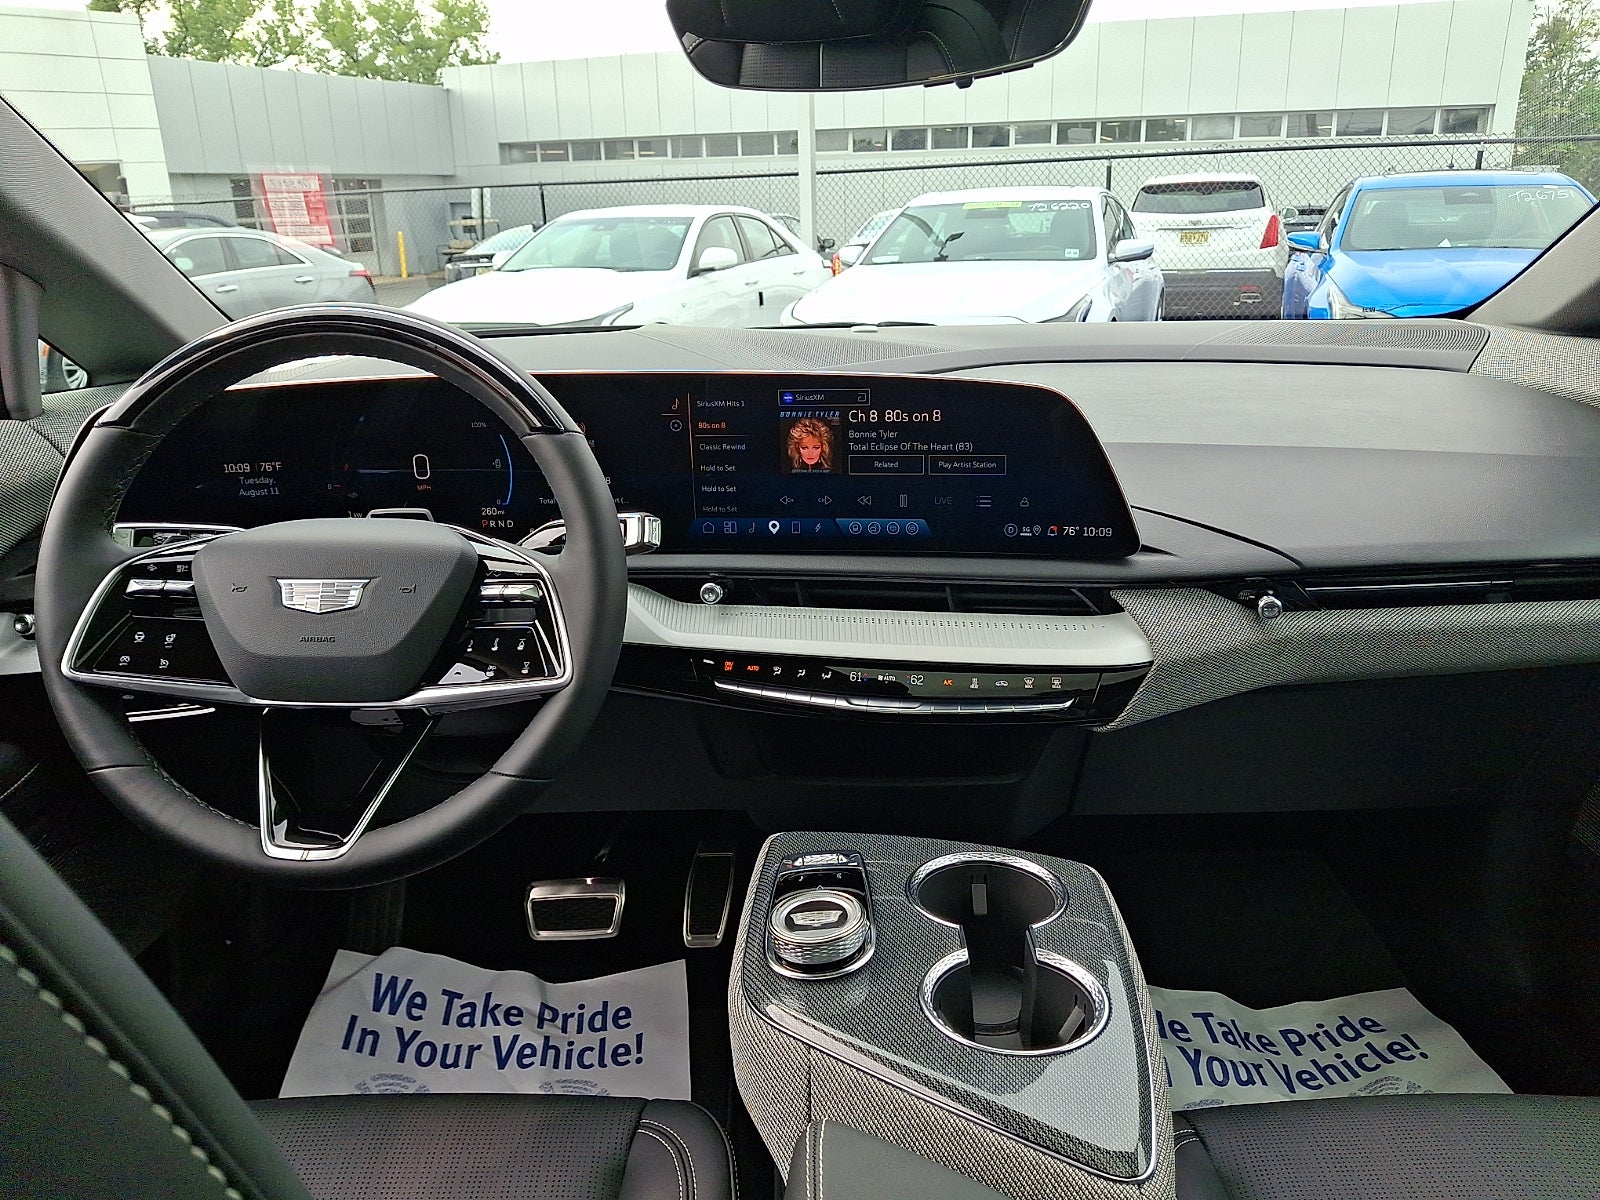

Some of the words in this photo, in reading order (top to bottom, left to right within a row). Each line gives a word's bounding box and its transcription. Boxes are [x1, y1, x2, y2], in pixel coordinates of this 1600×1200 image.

[696, 400, 726, 408] SiriusXM
[815, 410, 840, 418] TYLER
[848, 409, 866, 423] Ch
[869, 409, 878, 422] 8
[884, 409, 909, 423] 80s
[912, 412, 929, 422] on
[932, 409, 942, 422] 8
[698, 421, 711, 429] 80s
[848, 429, 877, 439] Bonnie
[879, 429, 898, 440] Tyler
[699, 443, 721, 451] Classic
[722, 443, 746, 451] Rewind
[848, 442, 869, 452] Total
[870, 441, 899, 453] Eclipse
[900, 441, 912, 452] Of
[912, 441, 928, 452] The
[930, 441, 954, 452] Heart
[955, 441, 973, 453] (83)
[223, 463, 251, 474] 10:09
[700, 464, 716, 472] Hold
[724, 464, 736, 472] Set
[873, 460, 899, 470] Related
[938, 461, 952, 471] Play
[953, 460, 972, 470] Artist
[972, 460, 997, 470] Station
[239, 489, 268, 498] August
[269, 487, 279, 495] 11
[934, 496, 952, 505] LIVE
[702, 505, 718, 513] Hold
[726, 505, 738, 513] Set
[1082, 526, 1113, 537] 10:09
[849, 671, 862, 682] 61
[910, 675, 924, 685] 62
[371, 972, 428, 1021] We
[441, 988, 524, 1029] Take
[537, 1000, 632, 1035] Pride
[1191, 1011, 1281, 1056] Take
[1278, 1015, 1387, 1056] Pride
[341, 1014, 381, 1058] In
[395, 1026, 483, 1070] Your
[492, 1032, 644, 1070] Vehicle!
[1176, 1045, 1269, 1088] Your
[1264, 1033, 1430, 1094] Vehicle!
